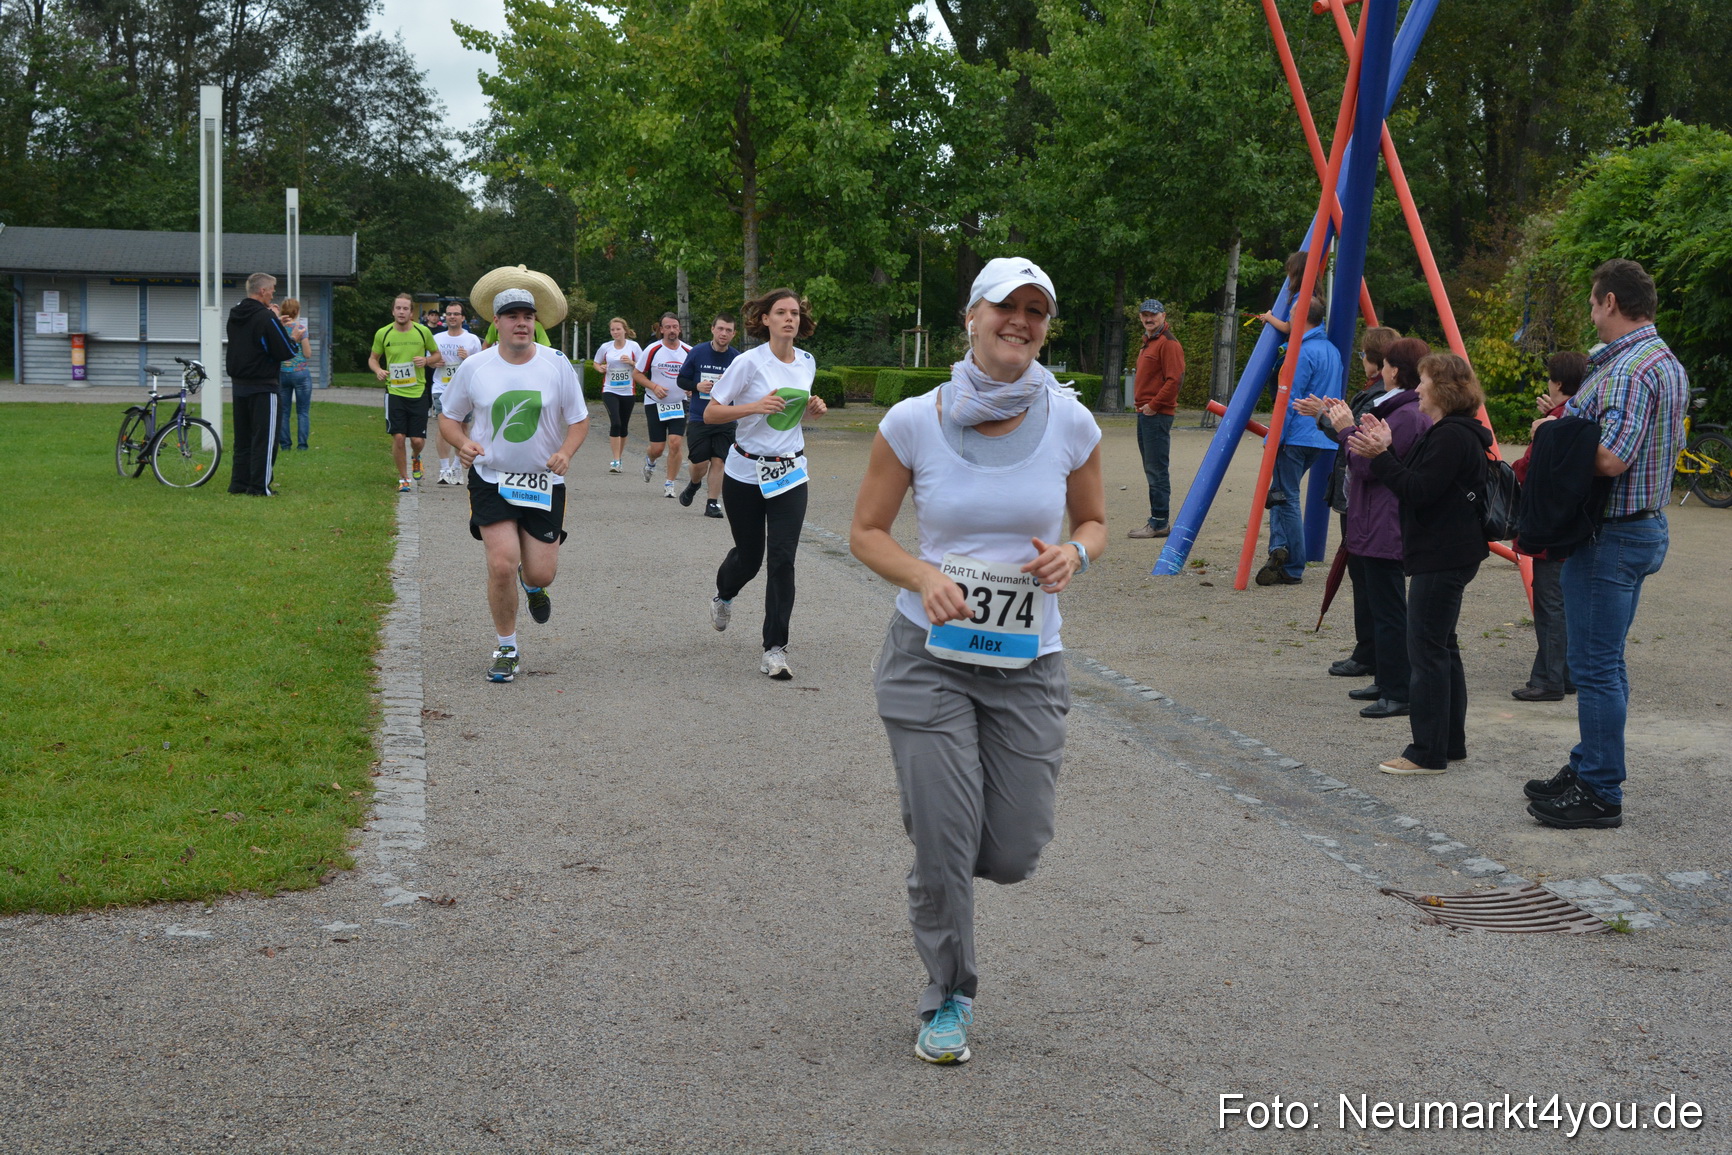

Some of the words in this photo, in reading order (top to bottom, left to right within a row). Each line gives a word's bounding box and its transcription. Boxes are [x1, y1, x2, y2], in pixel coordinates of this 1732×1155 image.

[394, 368, 411, 379] 214
[611, 372, 629, 381] 2895
[504, 471, 548, 491] 2286
[511, 491, 540, 501] Michael
[943, 564, 979, 580] PARTL
[981, 571, 1030, 585] Neumarkt
[968, 634, 1003, 652] Alex
